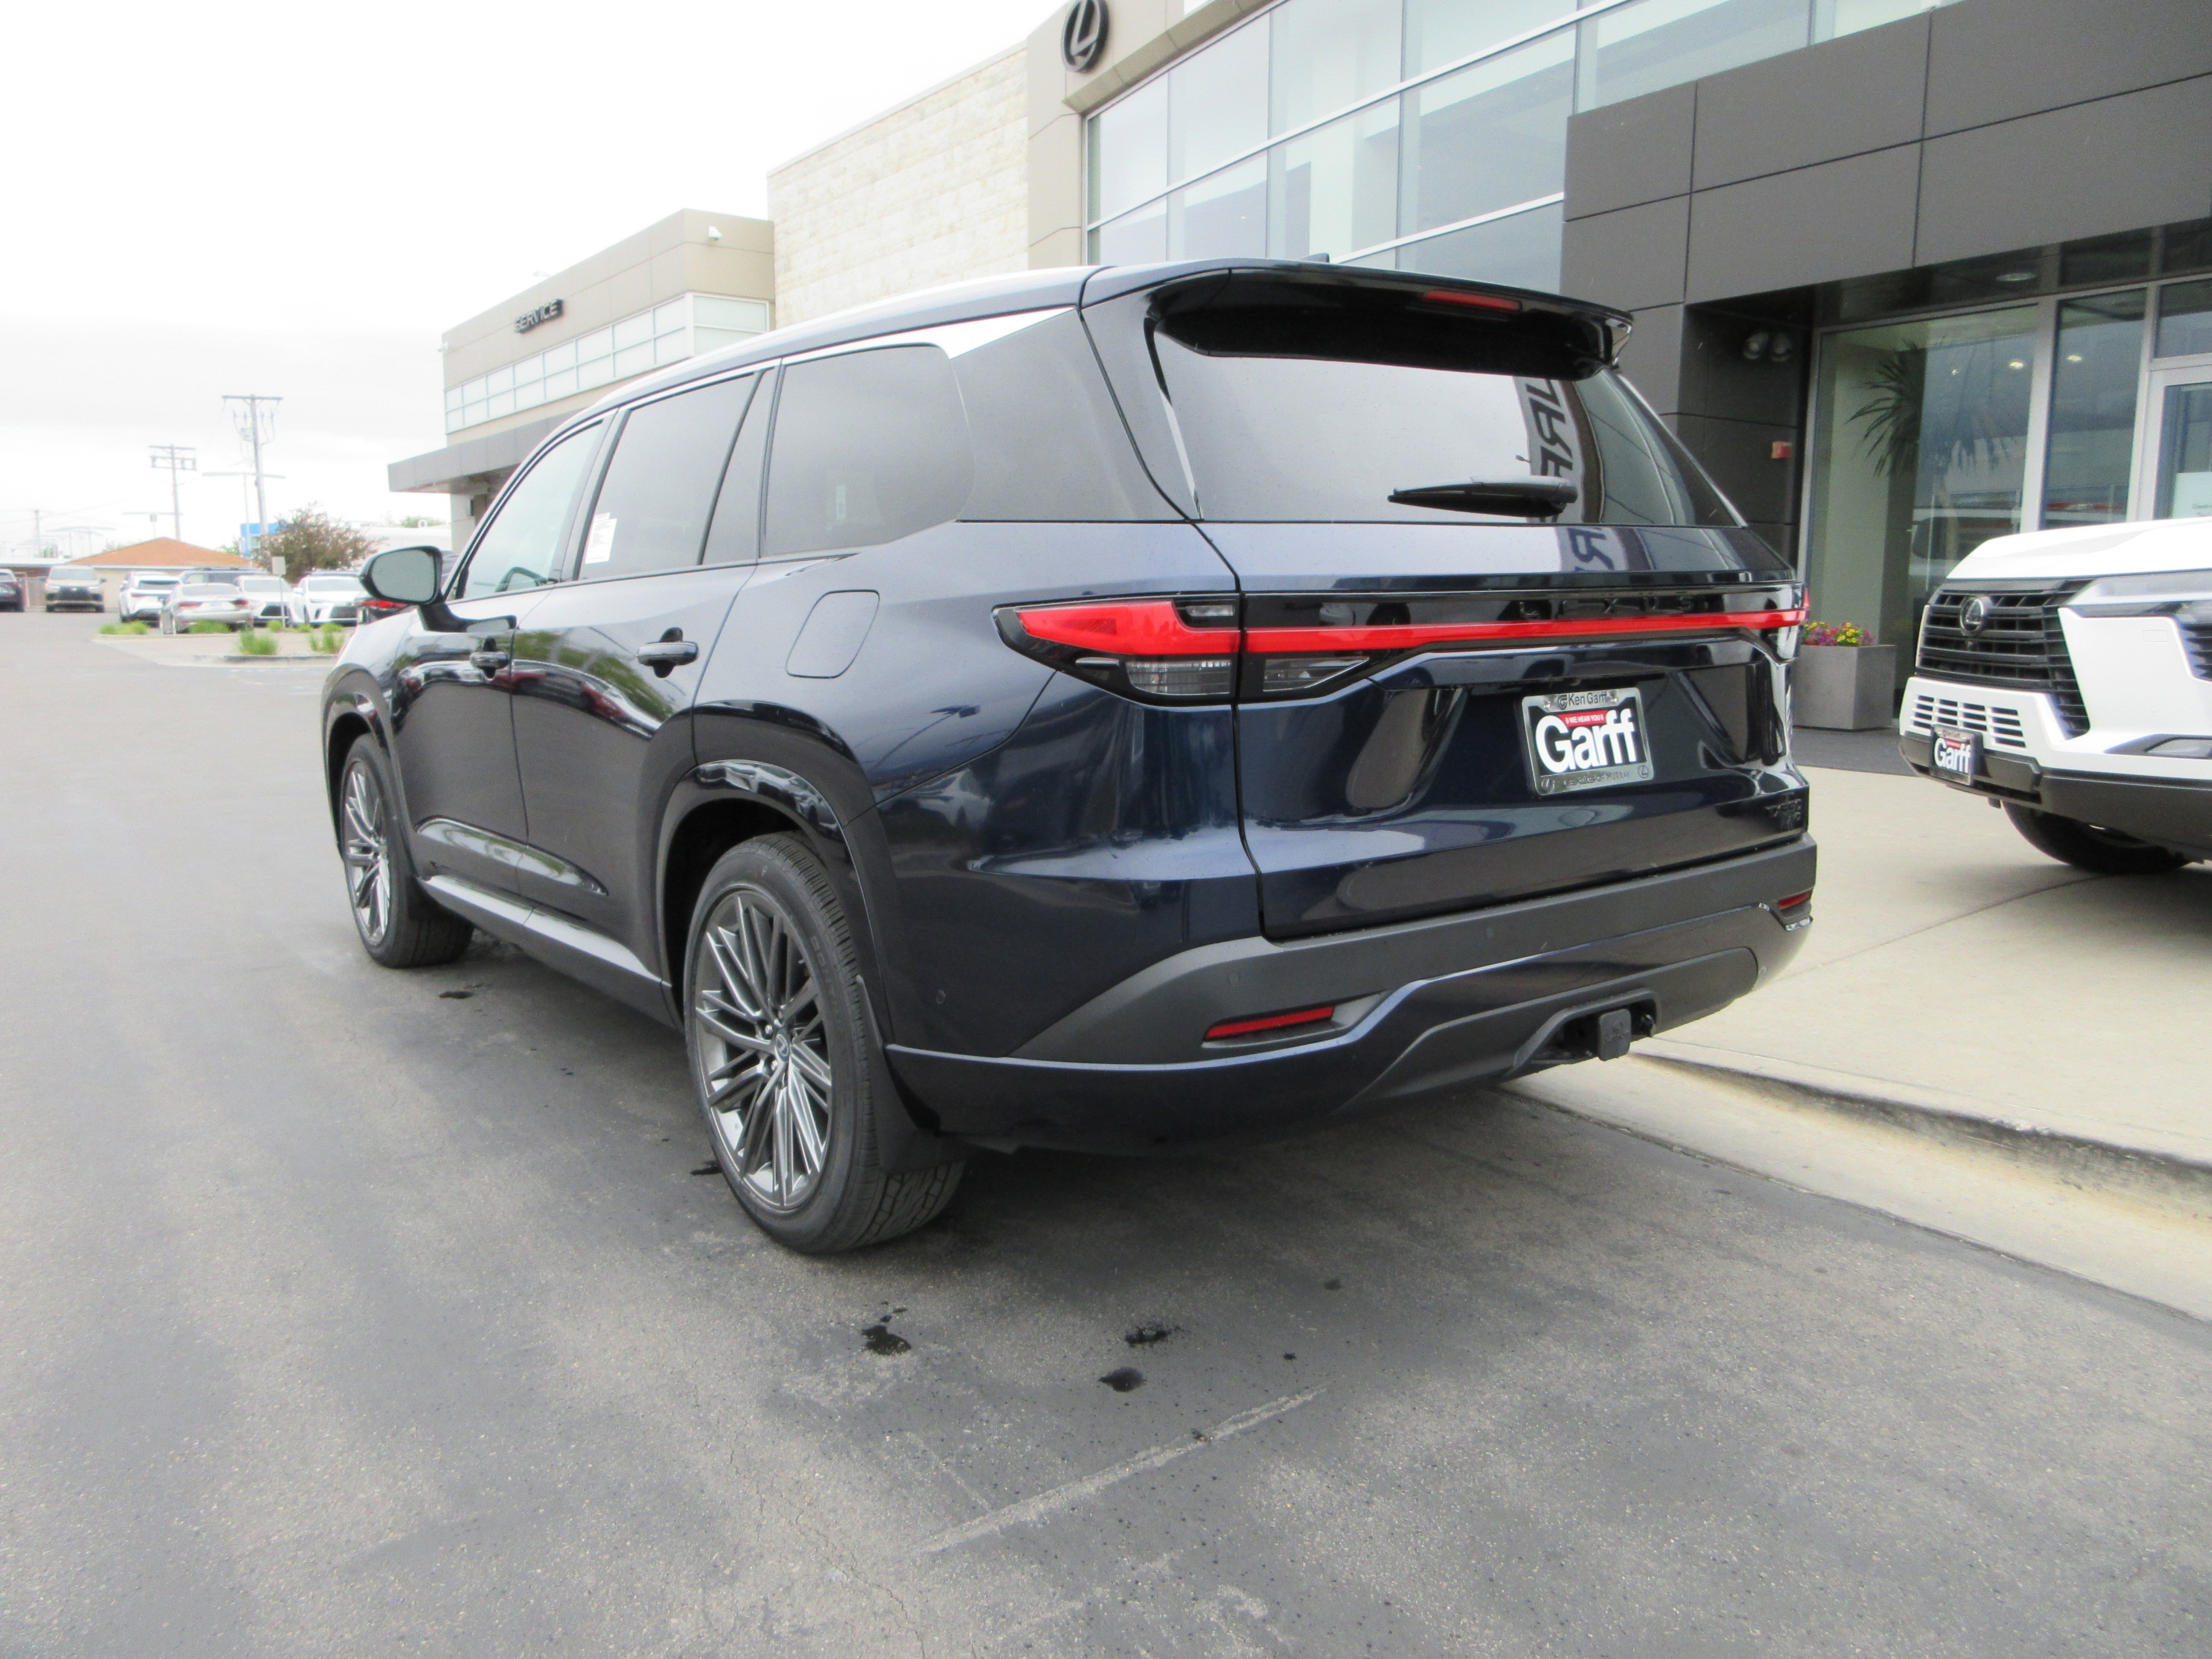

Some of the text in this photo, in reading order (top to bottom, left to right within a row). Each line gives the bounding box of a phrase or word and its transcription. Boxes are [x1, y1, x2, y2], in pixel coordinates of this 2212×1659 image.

[514, 299, 564, 333] SERVICE
[1569, 691, 1607, 705] Ken Garff
[1536, 708, 1637, 774] Garff
[1934, 737, 1970, 773] Garff
